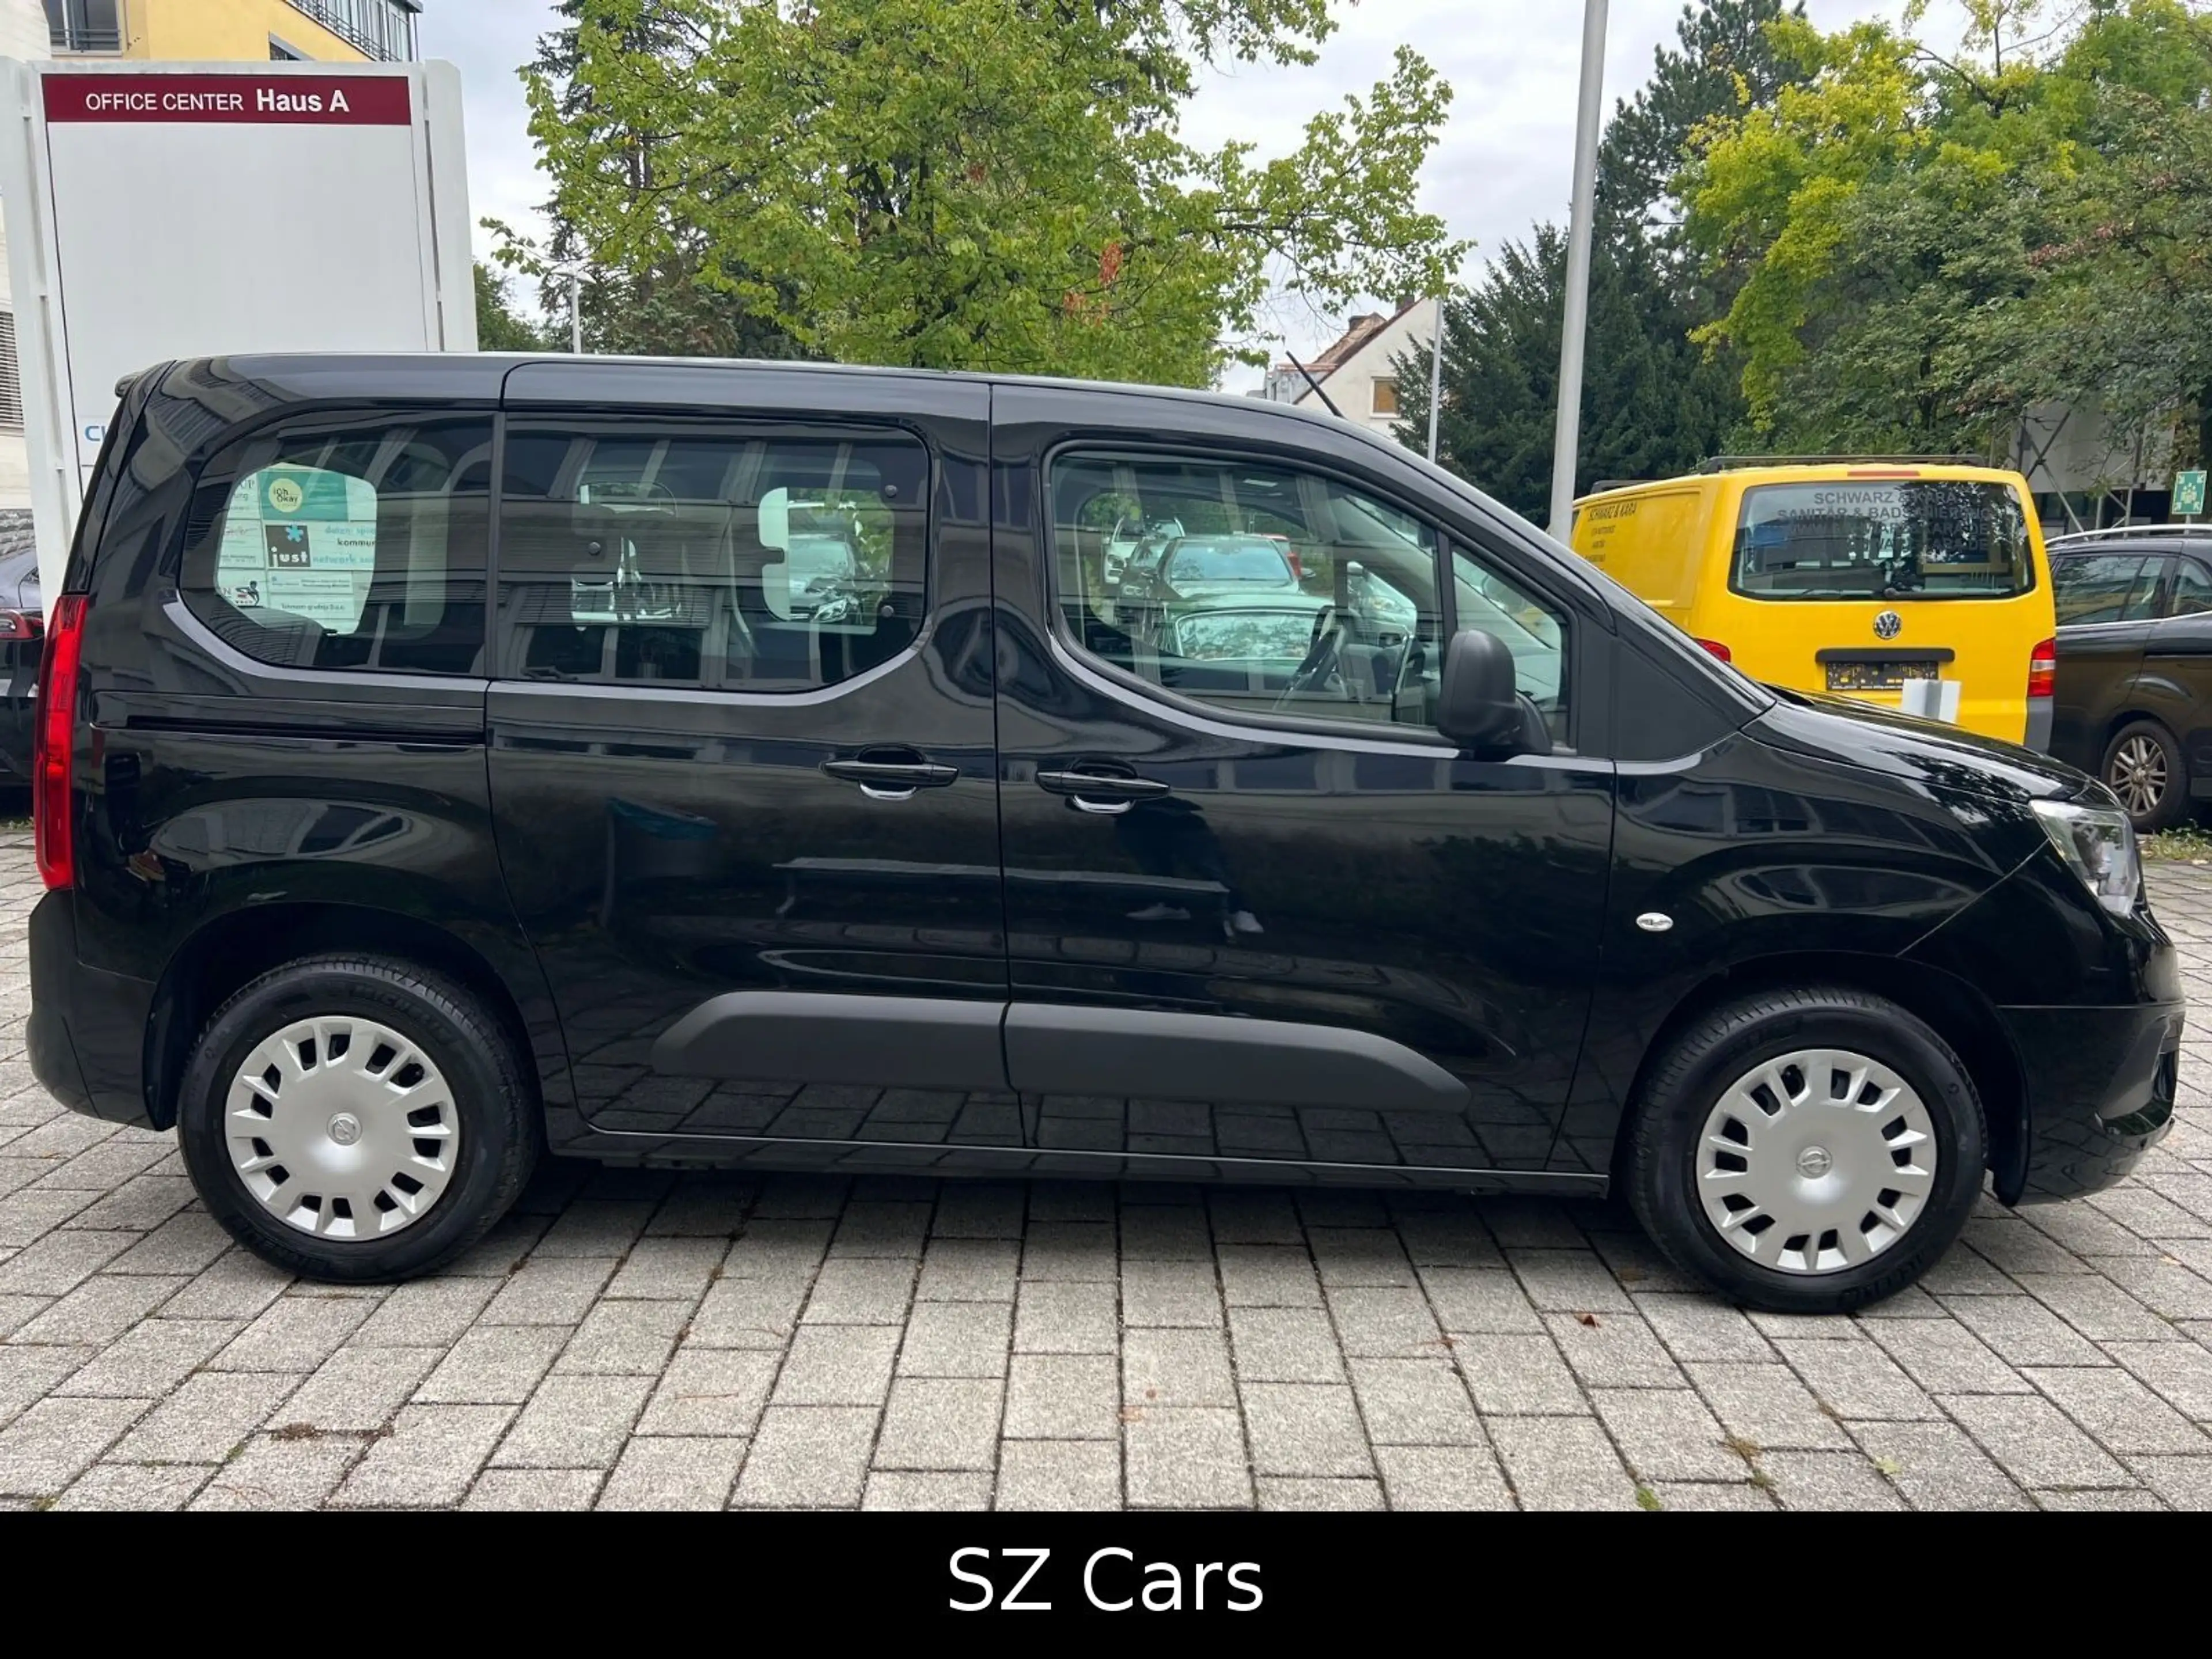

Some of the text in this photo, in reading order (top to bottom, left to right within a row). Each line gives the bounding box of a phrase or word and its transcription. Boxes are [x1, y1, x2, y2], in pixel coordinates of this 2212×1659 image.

[85, 89, 350, 112] OFFICE CENTER Haus A
[1813, 491, 1894, 505] SCHWARZ
[1914, 491, 1957, 504] KARA
[1777, 505, 1847, 520] SANITÄR
[270, 546, 308, 567] just
